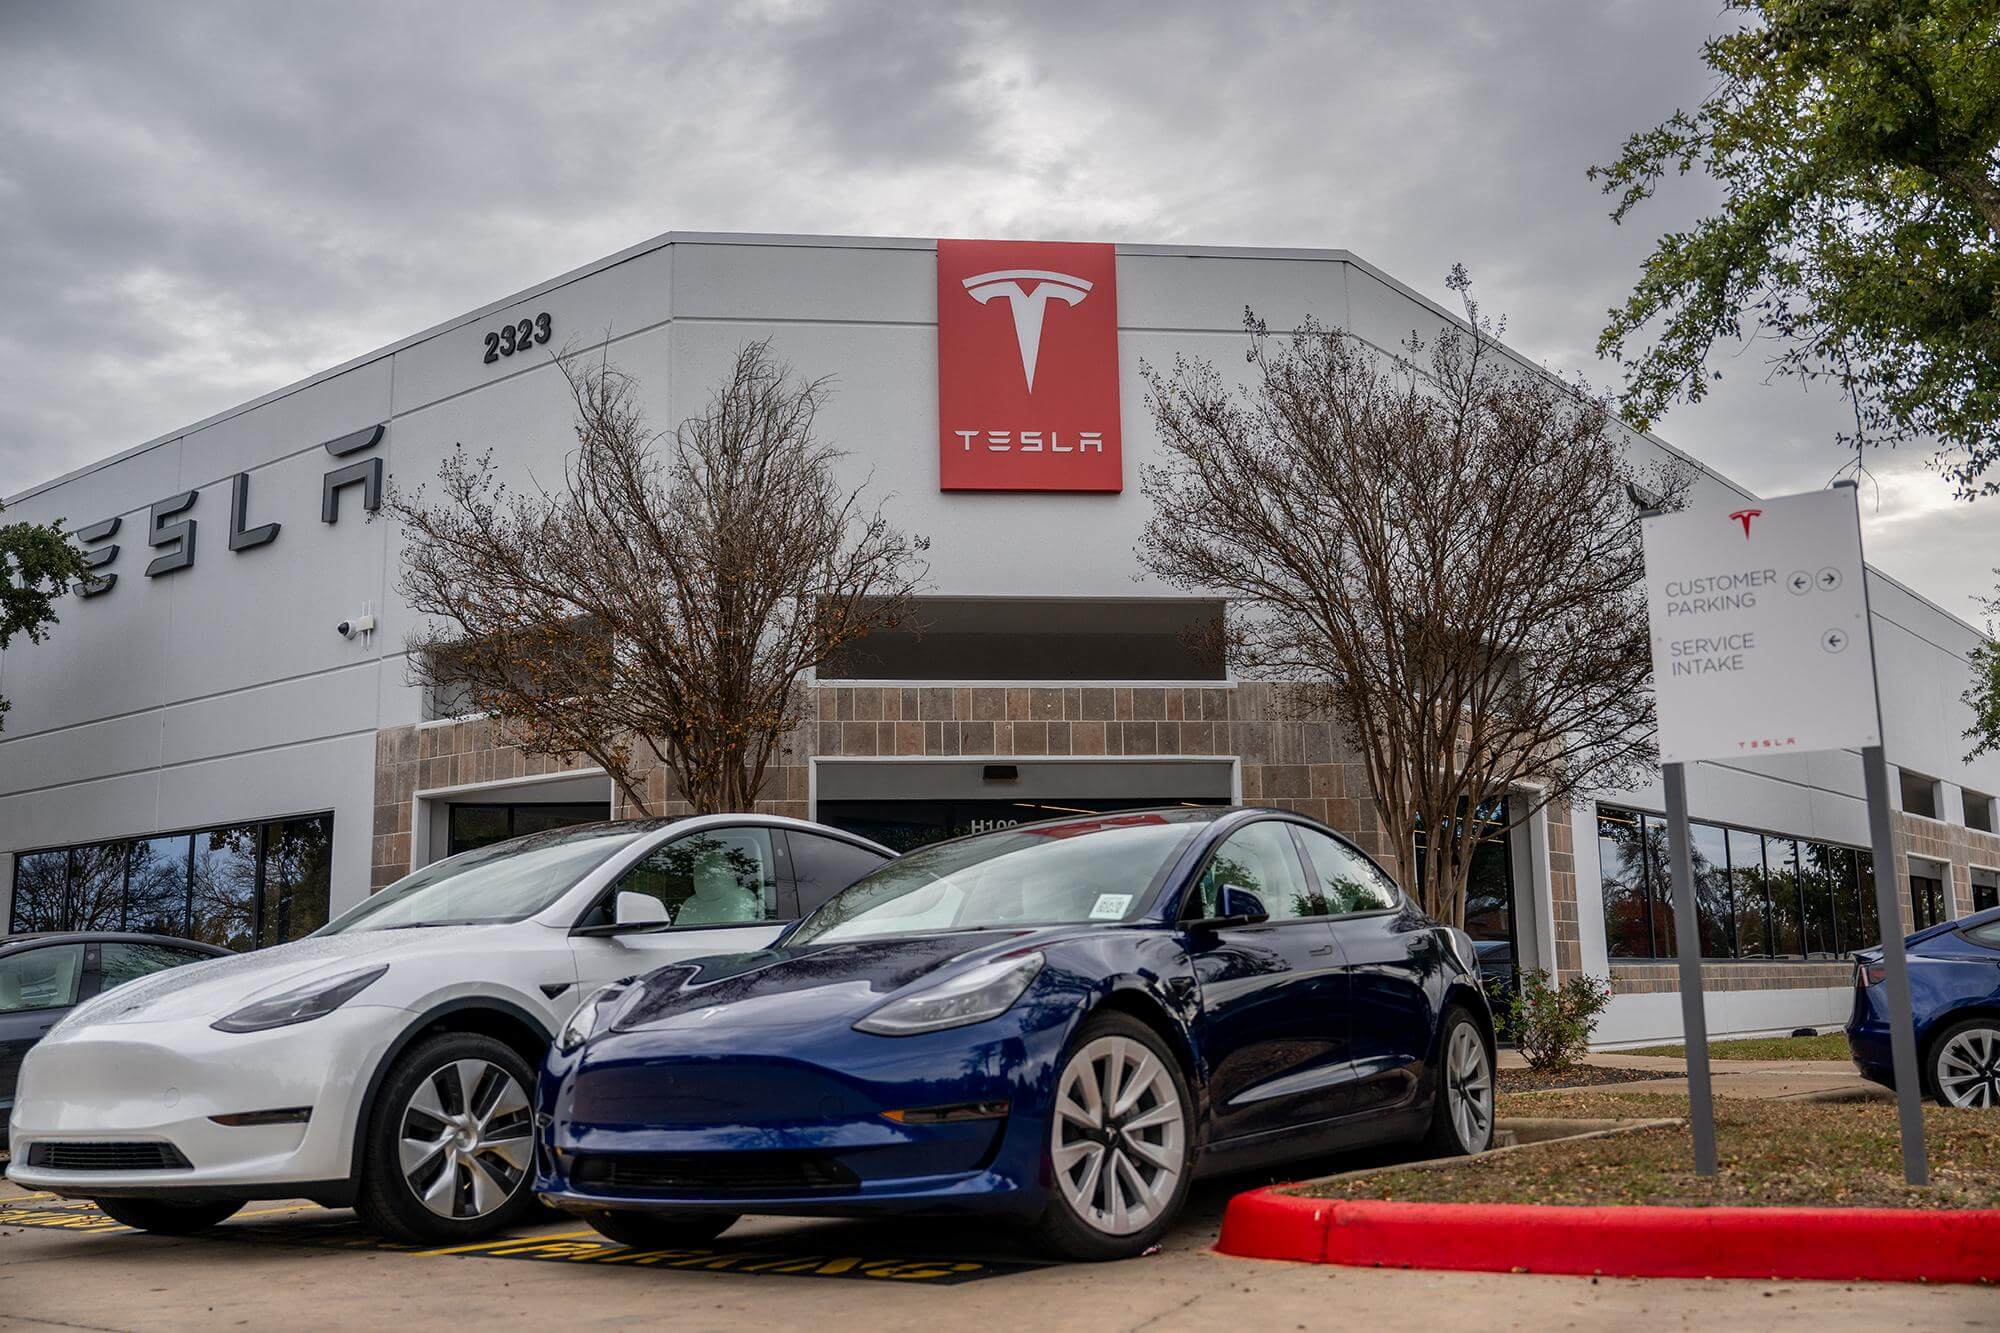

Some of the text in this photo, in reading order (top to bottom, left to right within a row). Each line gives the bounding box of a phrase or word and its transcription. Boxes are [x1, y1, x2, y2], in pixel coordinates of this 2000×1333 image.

[484, 312, 551, 364] 2323
[954, 430, 1102, 453] TESLA
[73, 424, 385, 599] ESLA
[1665, 569, 1777, 598] CUSTOMER
[1667, 592, 1756, 617] PARKING
[1670, 633, 1755, 657] SERVICE
[1672, 654, 1744, 677] INTAKE
[1738, 736, 1796, 749] TESLA
